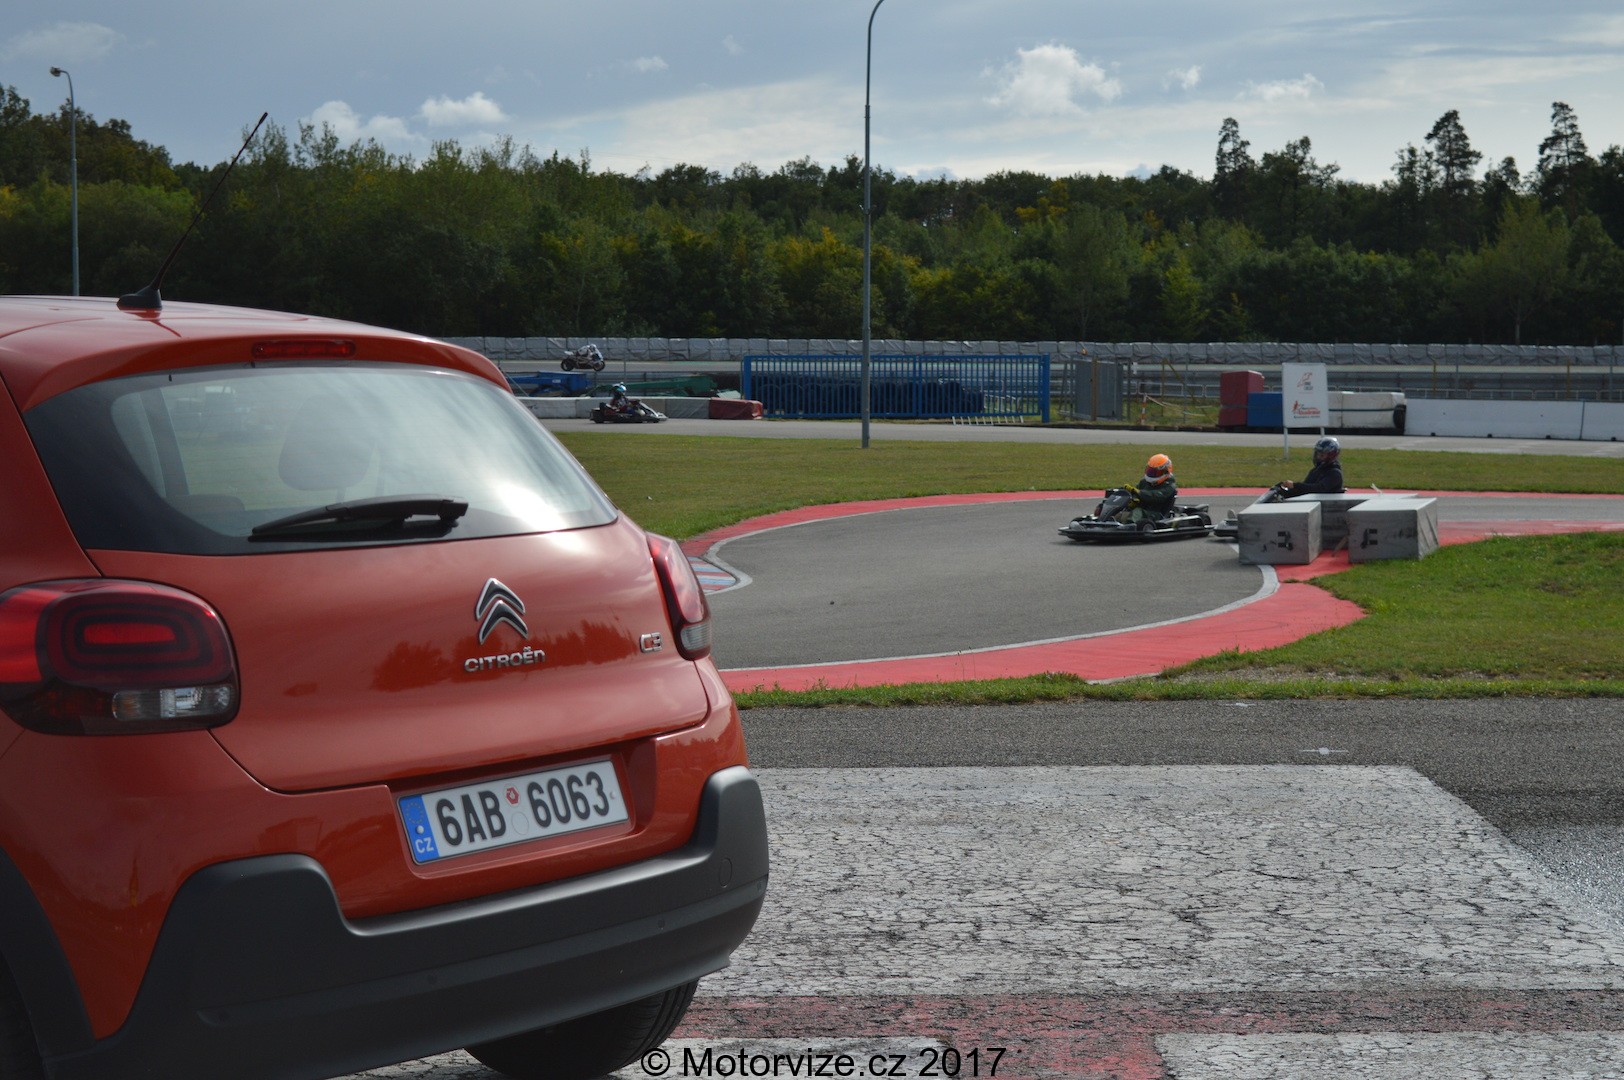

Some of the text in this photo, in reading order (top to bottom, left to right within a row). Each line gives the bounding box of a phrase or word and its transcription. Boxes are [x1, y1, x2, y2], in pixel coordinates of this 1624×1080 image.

[639, 632, 662, 653] C3
[435, 771, 610, 846] 6AB 6063
[415, 837, 435, 854] CZ
